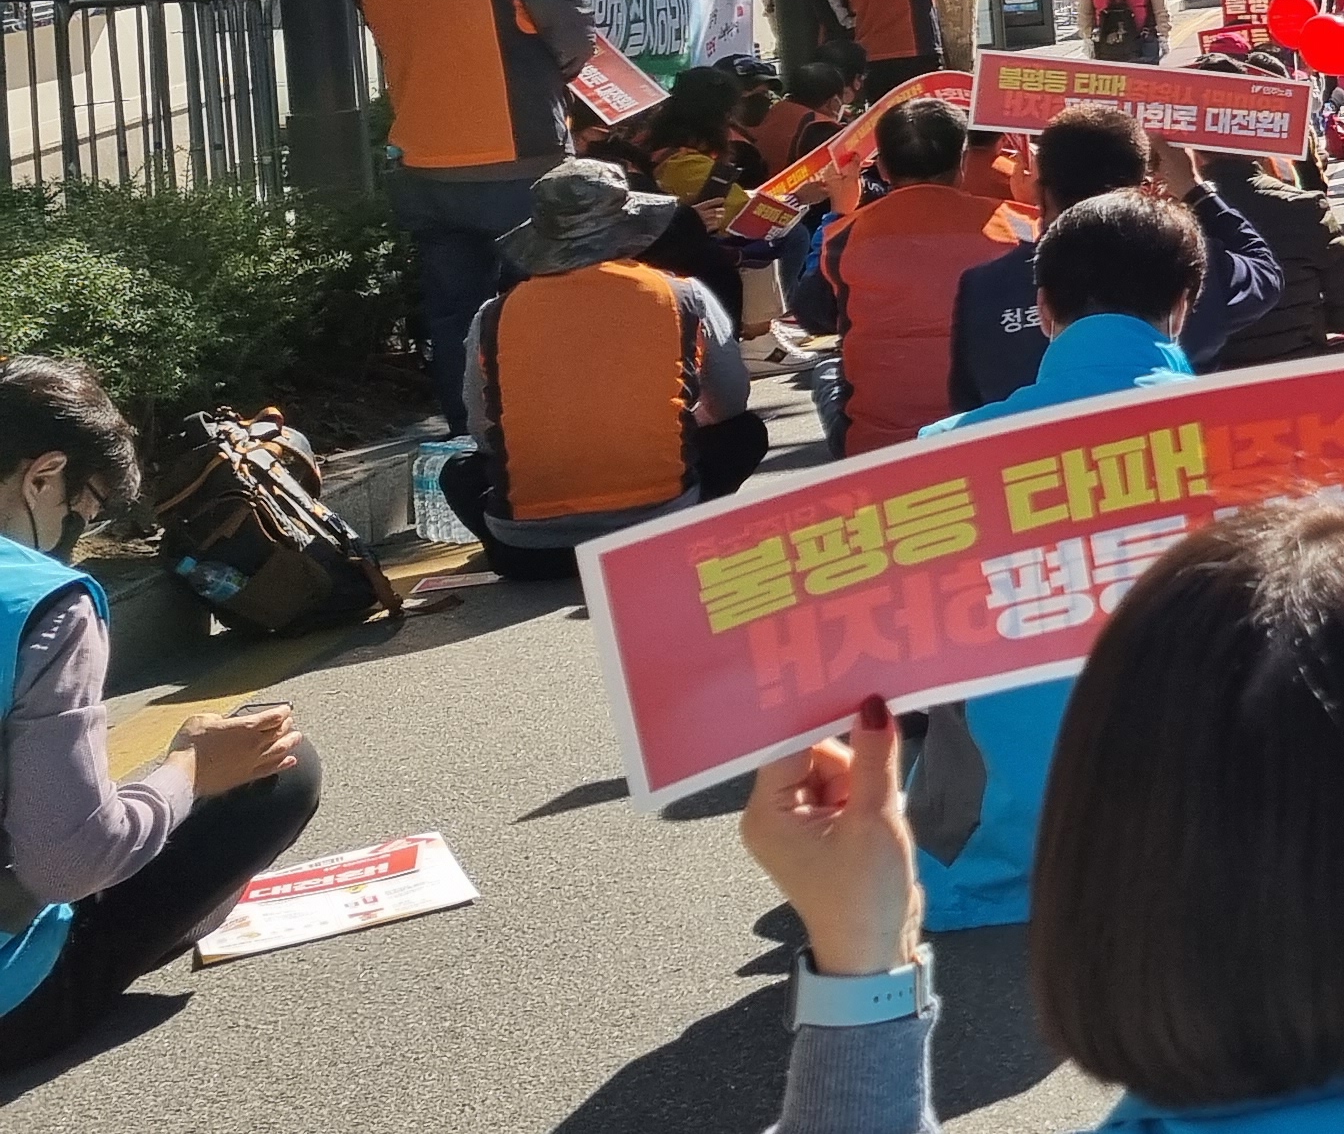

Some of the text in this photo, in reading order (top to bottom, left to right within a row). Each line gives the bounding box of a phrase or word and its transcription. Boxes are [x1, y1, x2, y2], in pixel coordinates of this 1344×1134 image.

[998, 65, 1127, 97] 불평등 타파!
[1204, 106, 1290, 139] 대전환!
[696, 420, 1212, 634] 불평등 타파!
